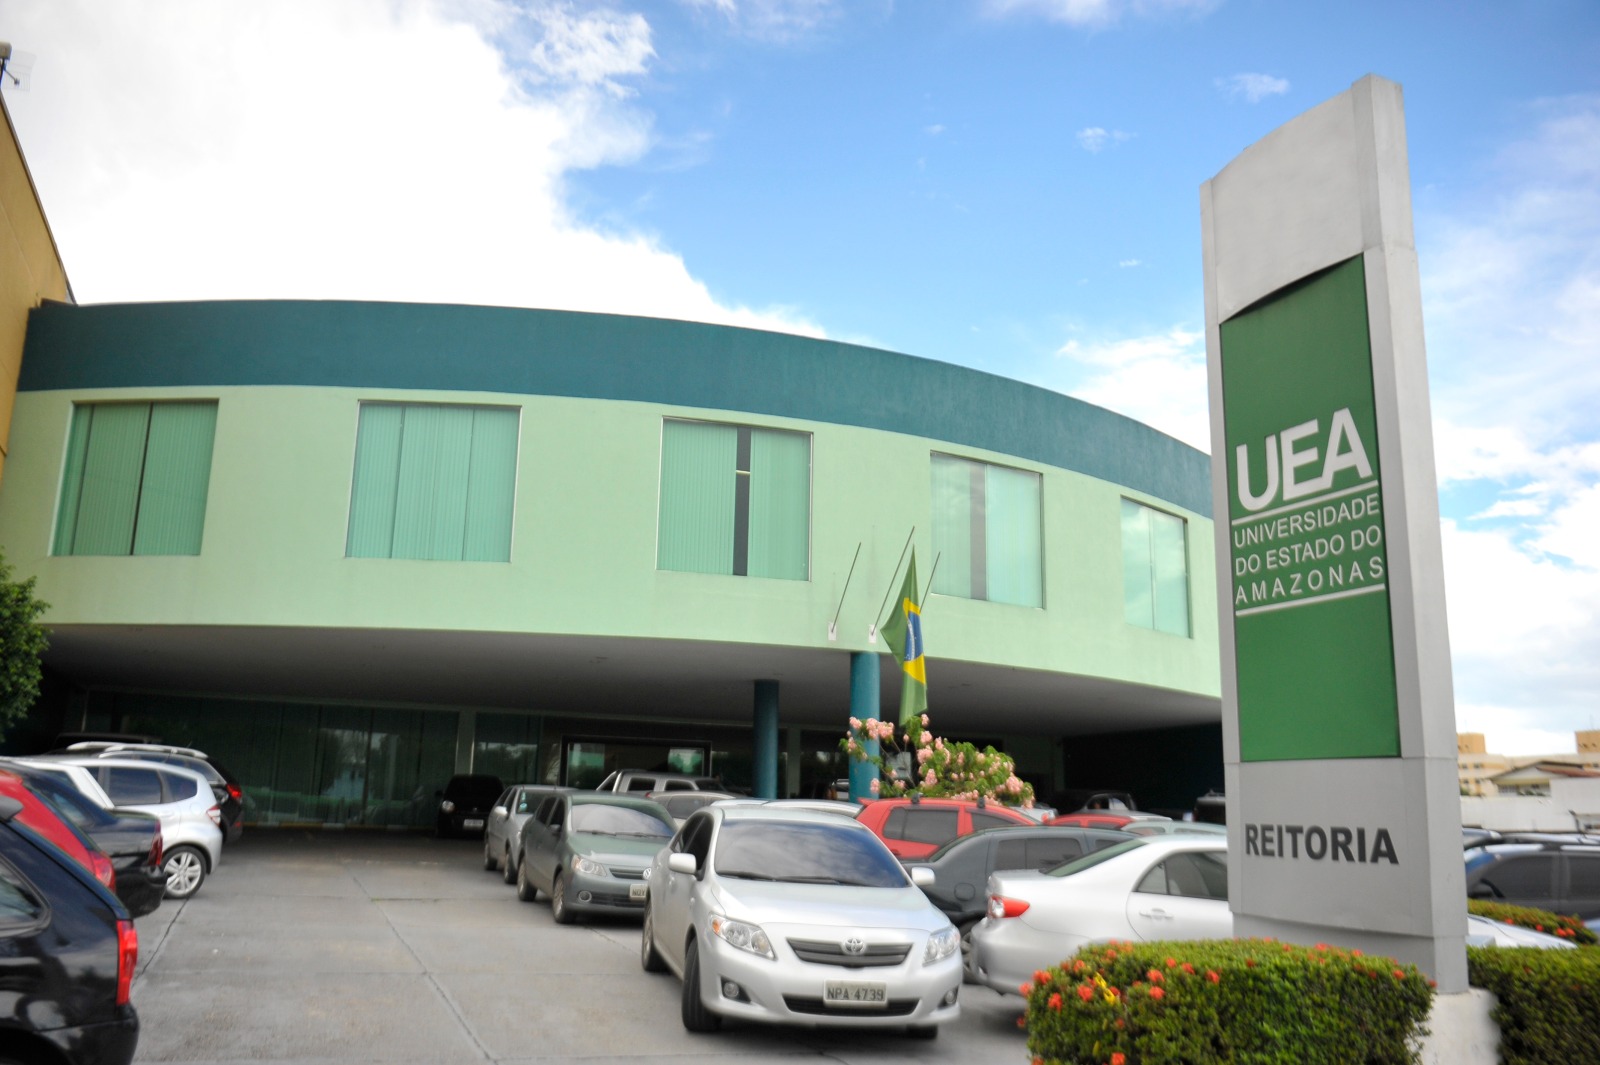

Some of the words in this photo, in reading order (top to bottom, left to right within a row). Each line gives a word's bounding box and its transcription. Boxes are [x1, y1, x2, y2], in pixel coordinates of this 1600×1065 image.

[1236, 407, 1373, 511] UEA
[1234, 492, 1379, 548] UNIVERSIDADE
[1235, 554, 1261, 576] DO
[1266, 534, 1345, 570] ESTADO
[1351, 525, 1381, 551] DO
[1235, 556, 1384, 605] AMAZONAS
[1245, 823, 1400, 865] REITORIA
[827, 987, 849, 1000] NPA
[854, 988, 884, 1001] 4739
